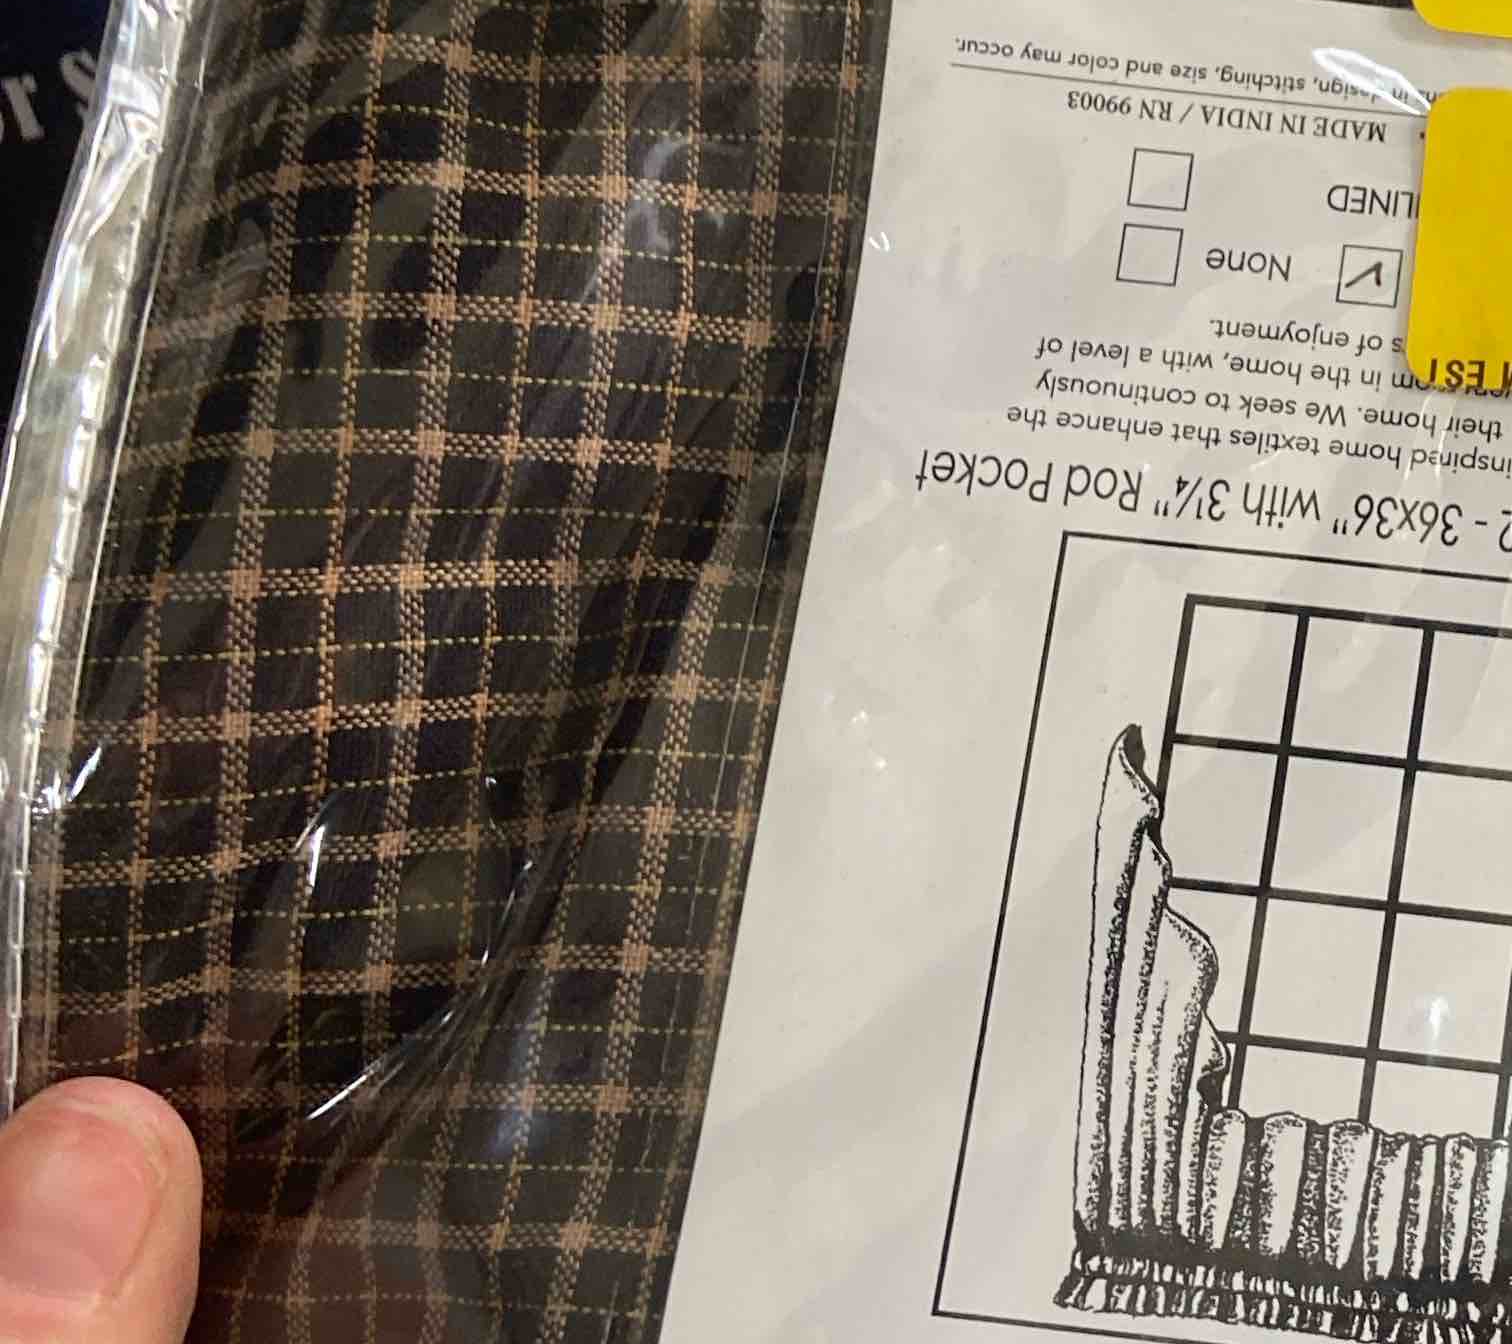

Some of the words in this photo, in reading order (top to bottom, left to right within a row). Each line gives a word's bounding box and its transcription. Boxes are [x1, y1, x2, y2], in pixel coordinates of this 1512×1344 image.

[954, 37, 1014, 57] occur.
[1019, 41, 1061, 63] may
[1066, 51, 1119, 73] color
[1124, 58, 1163, 78] and
[1169, 63, 1207, 84] size
[1214, 63, 1305, 93] stitching,
[1066, 89, 1131, 114] 99003
[1138, 98, 1172, 121] RN
[1200, 104, 1272, 131] INDIA
[1279, 113, 1306, 135] IN
[1312, 115, 1386, 143] MADE
[1326, 183, 1421, 219] LINED
[1204, 246, 1291, 281] None
[1033, 335, 1062, 359] of
[1209, 318, 1349, 350] enjoyment.
[1353, 333, 1383, 357] of
[1069, 339, 1129, 368] level
[1138, 345, 1152, 362] a
[1161, 348, 1213, 372] with
[1222, 351, 1301, 385] home,
[1309, 363, 1350, 389] the
[1359, 368, 1381, 392] in
[1034, 367, 1196, 405] continuously
[1203, 391, 1230, 411] to
[1238, 394, 1297, 418] seek
[1304, 401, 1346, 427] We
[1006, 405, 1046, 431] the
[1055, 410, 1163, 441] enhance
[1356, 406, 1436, 437] home.
[1445, 415, 1502, 443] their
[1170, 422, 1221, 450] that
[1228, 428, 1319, 455] textiles
[1328, 438, 1401, 469] home
[914, 448, 1053, 502] Pocket
[1062, 463, 1142, 512] Rod
[1241, 481, 1320, 529] with
[1331, 493, 1463, 546] 36x36"
